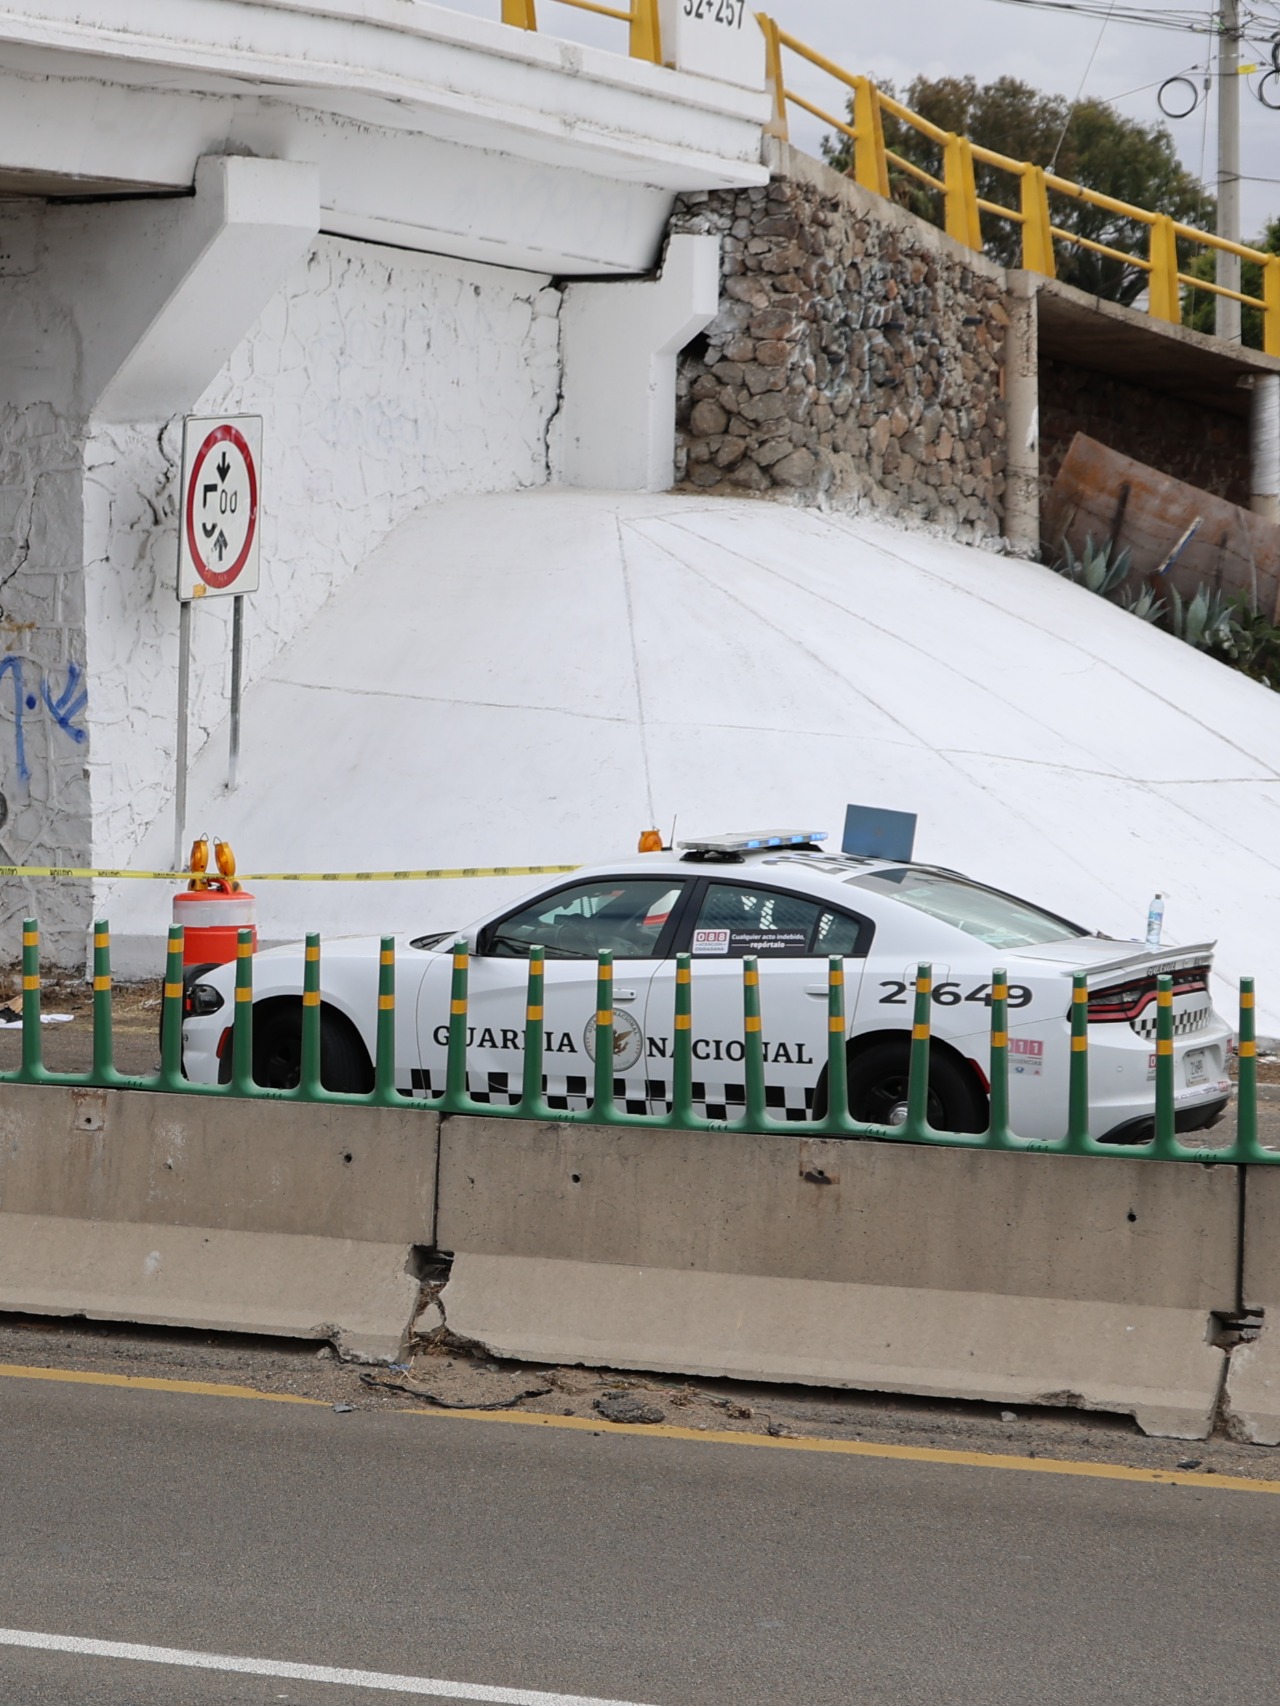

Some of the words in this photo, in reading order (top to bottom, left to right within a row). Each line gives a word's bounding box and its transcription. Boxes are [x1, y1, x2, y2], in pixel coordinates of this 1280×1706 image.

[697, 932, 726, 941] 088
[750, 941, 785, 949] repórtalo
[433, 1025, 578, 1053] GUARIA
[646, 1037, 813, 1064] NCIOAL
[1008, 1041, 1039, 1054] 11
